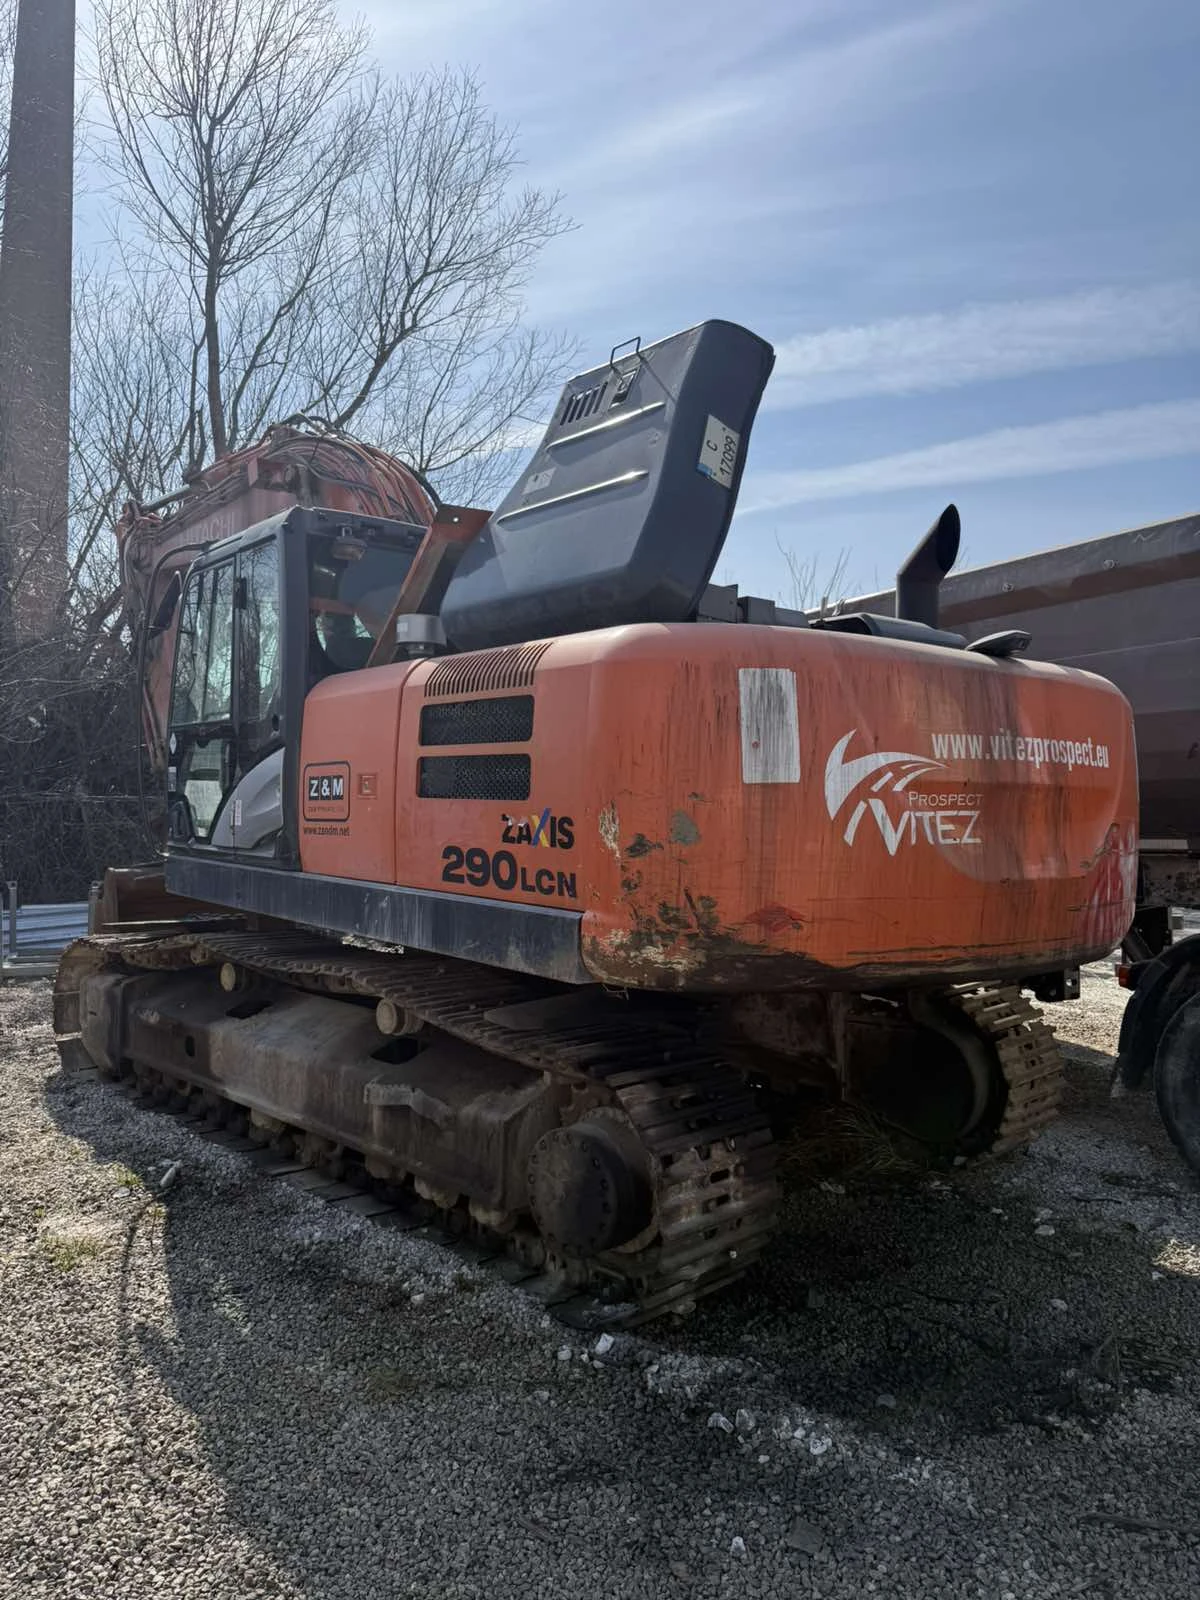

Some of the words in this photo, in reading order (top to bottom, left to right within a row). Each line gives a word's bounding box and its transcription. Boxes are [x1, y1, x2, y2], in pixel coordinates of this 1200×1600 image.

[706, 440, 718, 452] C
[931, 731, 1110, 771] www.vitezprospect.eu
[501, 807, 575, 849] ZAXIS
[866, 798, 983, 857] VITEZ
[442, 845, 518, 891] 290
[520, 866, 577, 899] LCN
